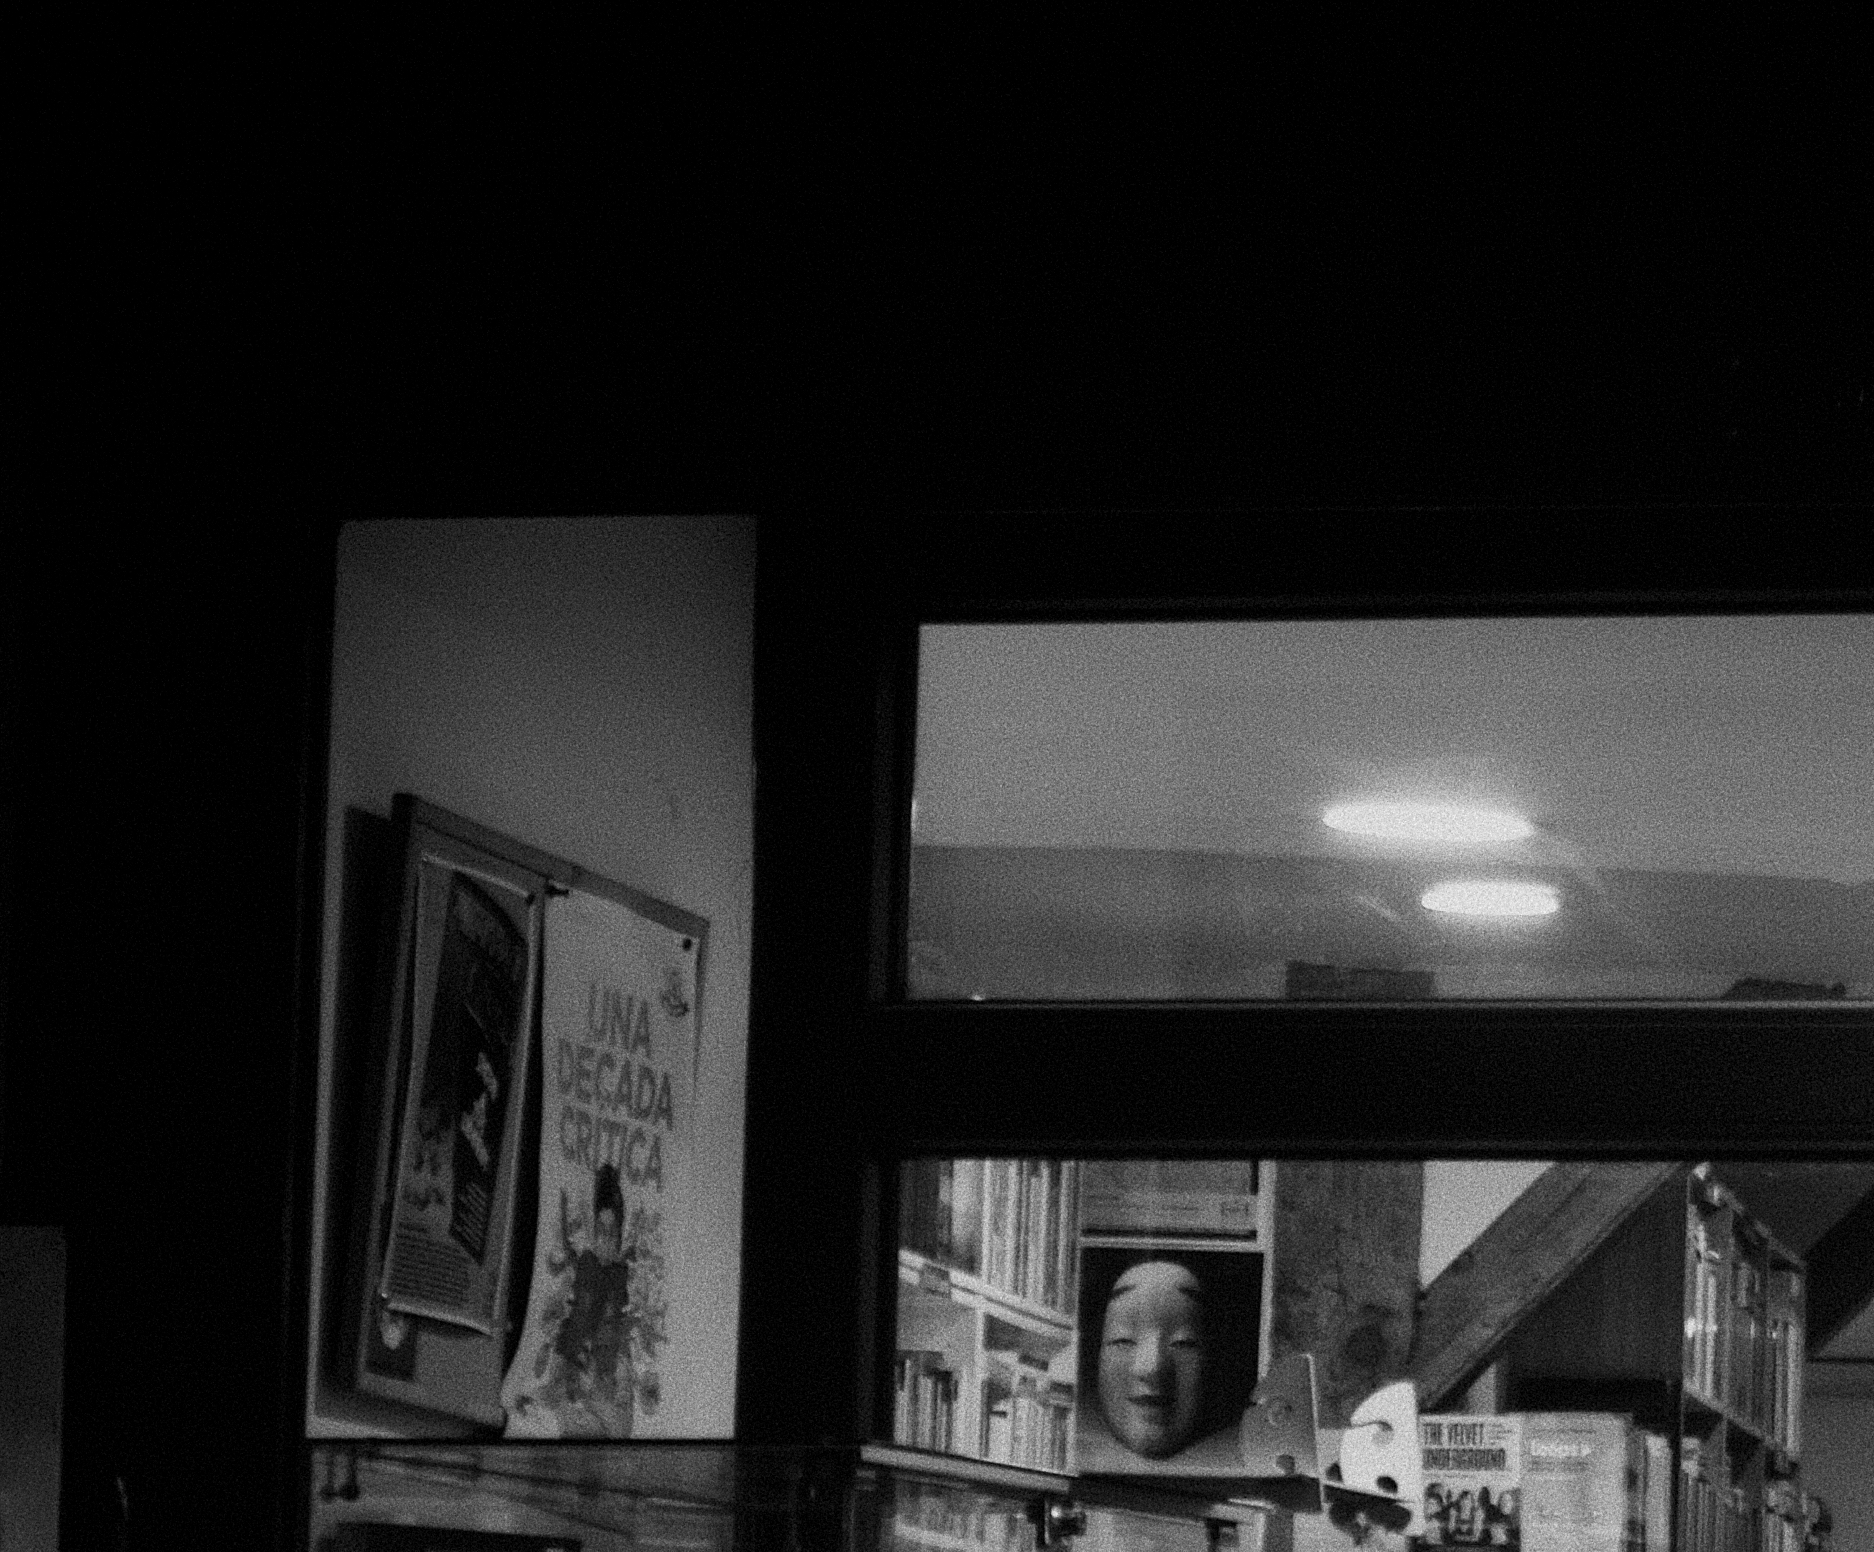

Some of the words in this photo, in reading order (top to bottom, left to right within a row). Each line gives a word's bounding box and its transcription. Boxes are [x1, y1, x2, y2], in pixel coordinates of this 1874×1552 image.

[588, 981, 655, 1062] UNA
[557, 1036, 677, 1133] DECADA
[1447, 1422, 1486, 1446] VELVET
